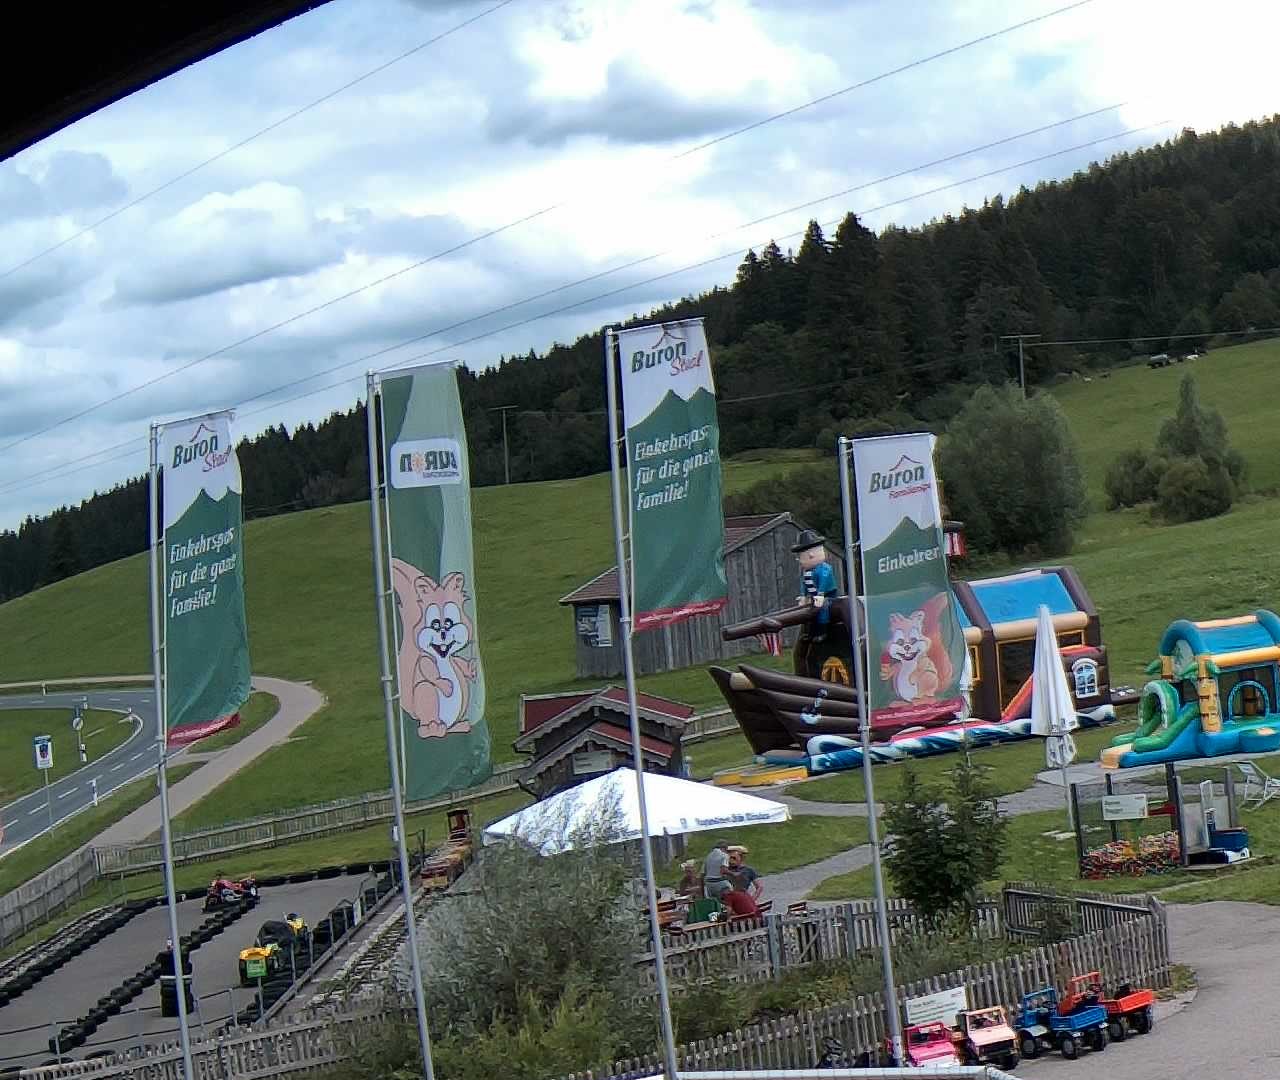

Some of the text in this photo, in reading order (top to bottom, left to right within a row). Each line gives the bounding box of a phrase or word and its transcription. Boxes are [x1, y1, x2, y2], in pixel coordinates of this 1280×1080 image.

[632, 341, 687, 374] Buron
[172, 434, 218, 469] Buron
[633, 466, 657, 492] für
[659, 459, 681, 479] die
[868, 464, 926, 494] Buron
[636, 479, 688, 511] Familie!
[167, 570, 188, 597] für
[190, 561, 208, 584] die
[169, 583, 217, 618] Familie!
